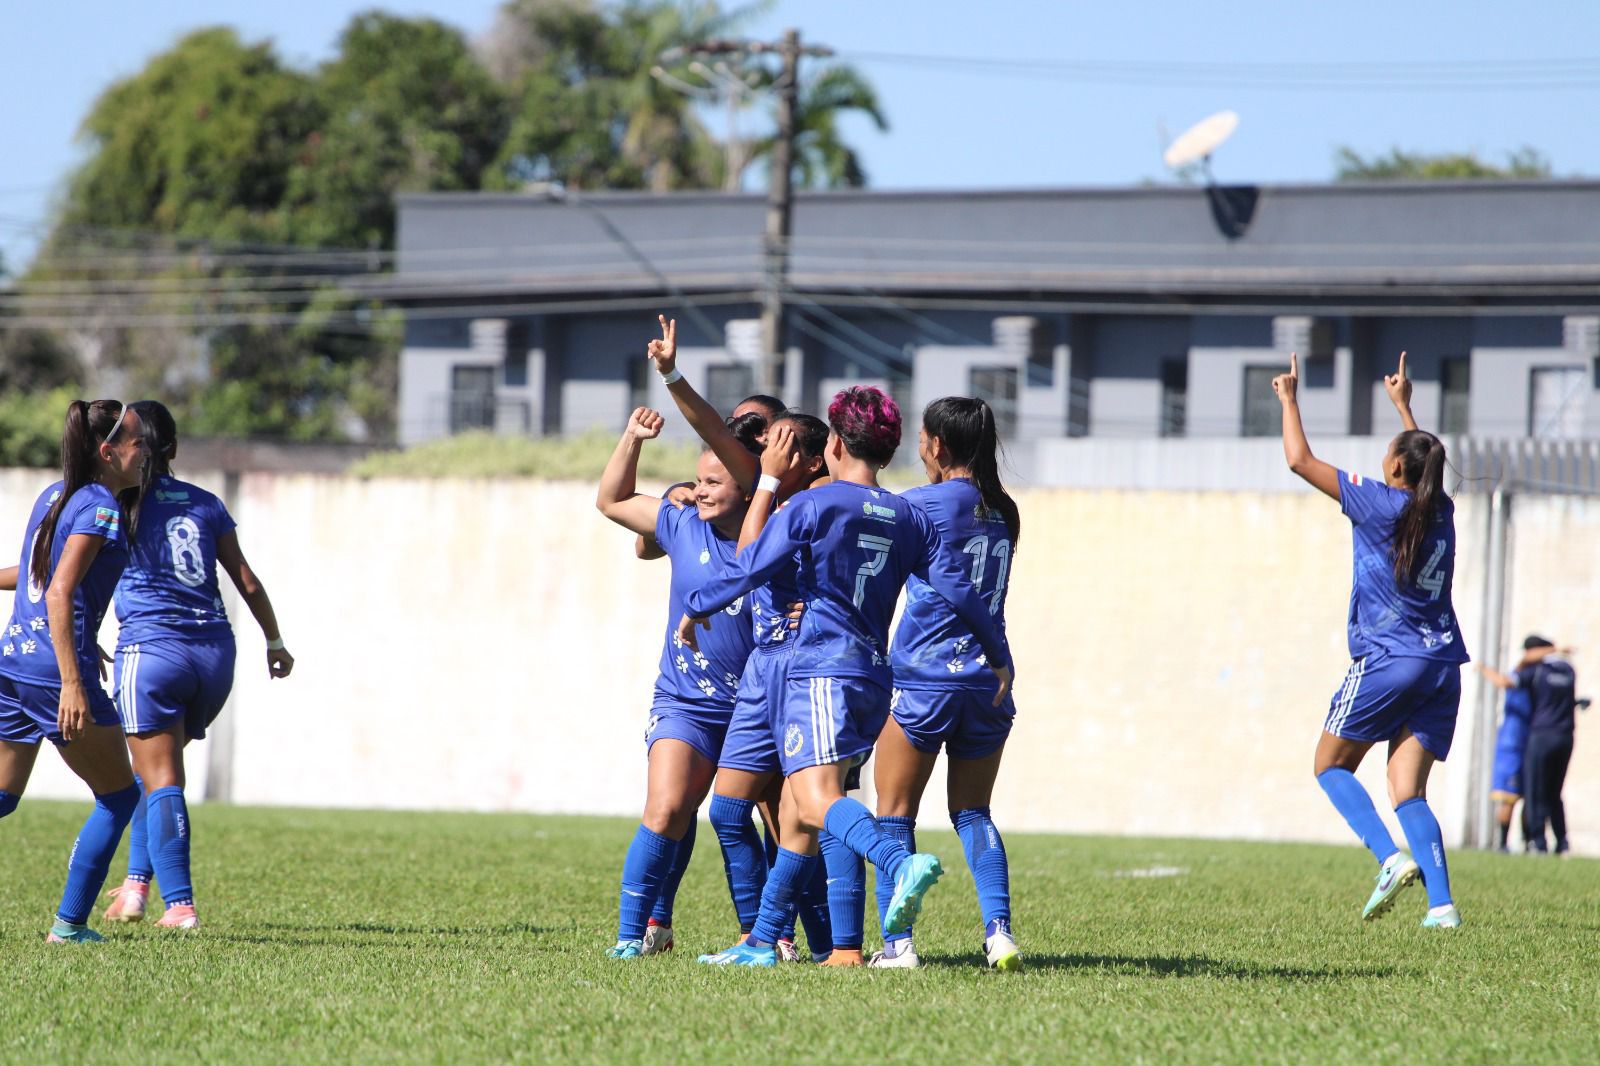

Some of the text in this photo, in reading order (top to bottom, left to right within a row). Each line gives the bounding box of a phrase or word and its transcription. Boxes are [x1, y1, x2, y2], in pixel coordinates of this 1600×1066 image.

[166, 516, 207, 587] 8
[853, 533, 893, 610] 7
[963, 535, 1010, 616] 11
[1416, 540, 1446, 600] 4
